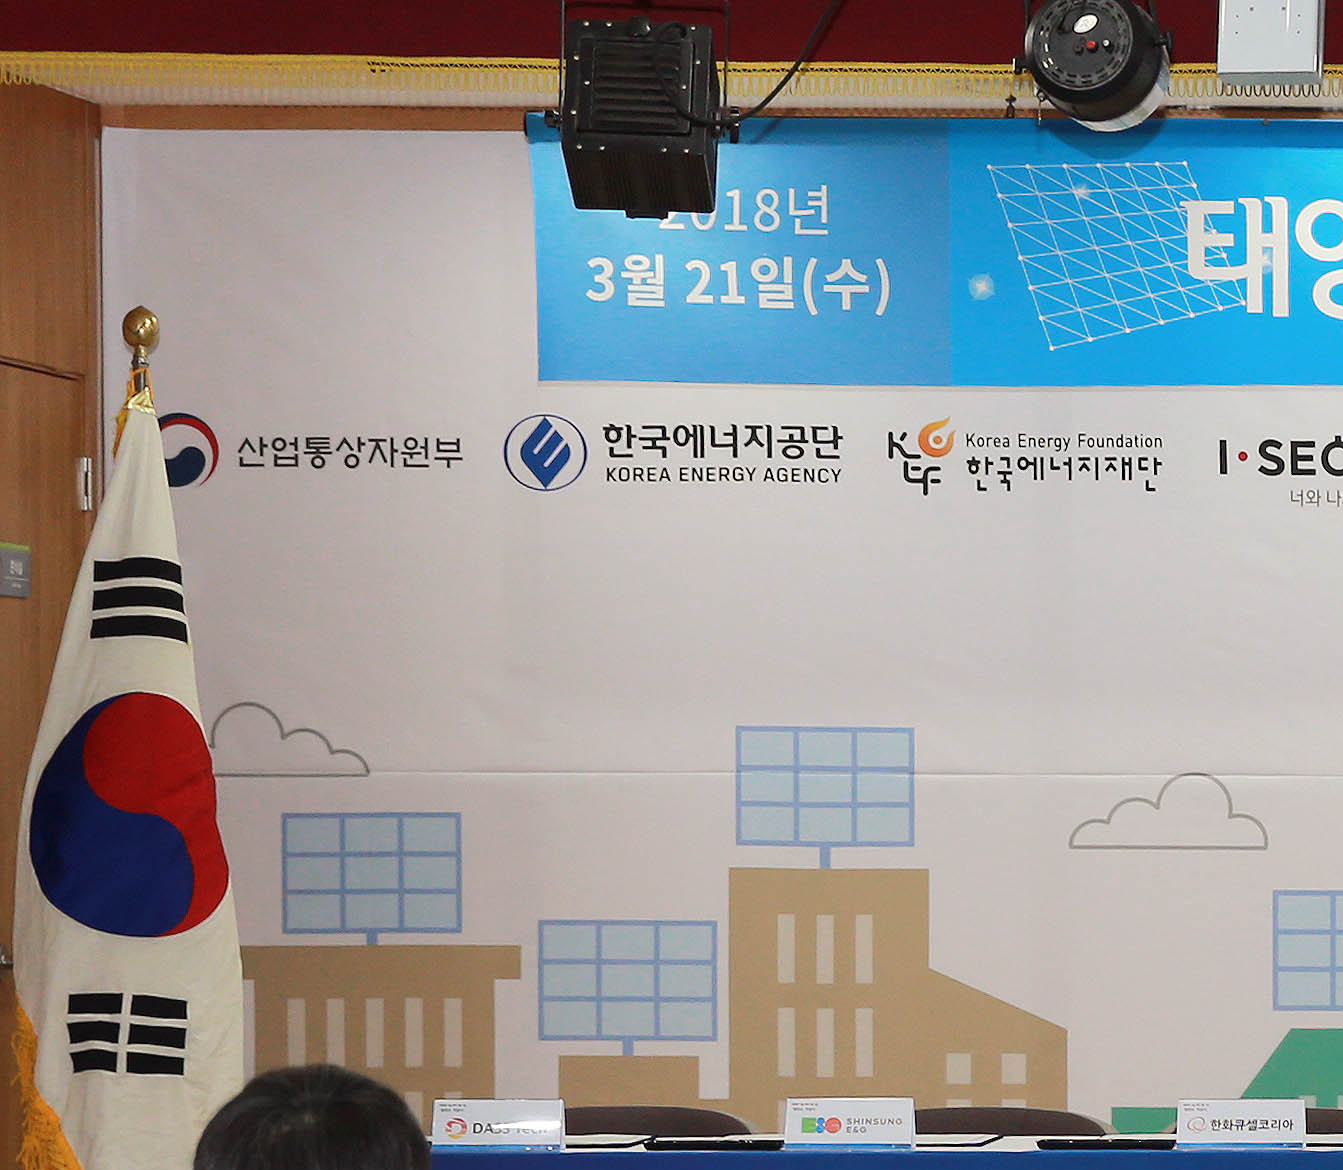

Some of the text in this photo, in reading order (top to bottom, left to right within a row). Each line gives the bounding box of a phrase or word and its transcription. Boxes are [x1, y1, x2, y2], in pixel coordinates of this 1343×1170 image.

[585, 252, 890, 316] 3월 21일(수)
[237, 436, 464, 470] 산업통상자원부
[602, 423, 844, 460] 한국에너지공단
[965, 433, 1163, 453] Korea Energy Foundation
[606, 466, 842, 484] KOREA ENERGY AGENCY
[966, 456, 1163, 492] 한국에너지재단
[1290, 489, 1322, 508] 너와
[1211, 1119, 1294, 1132] 한화큐셀코리아
